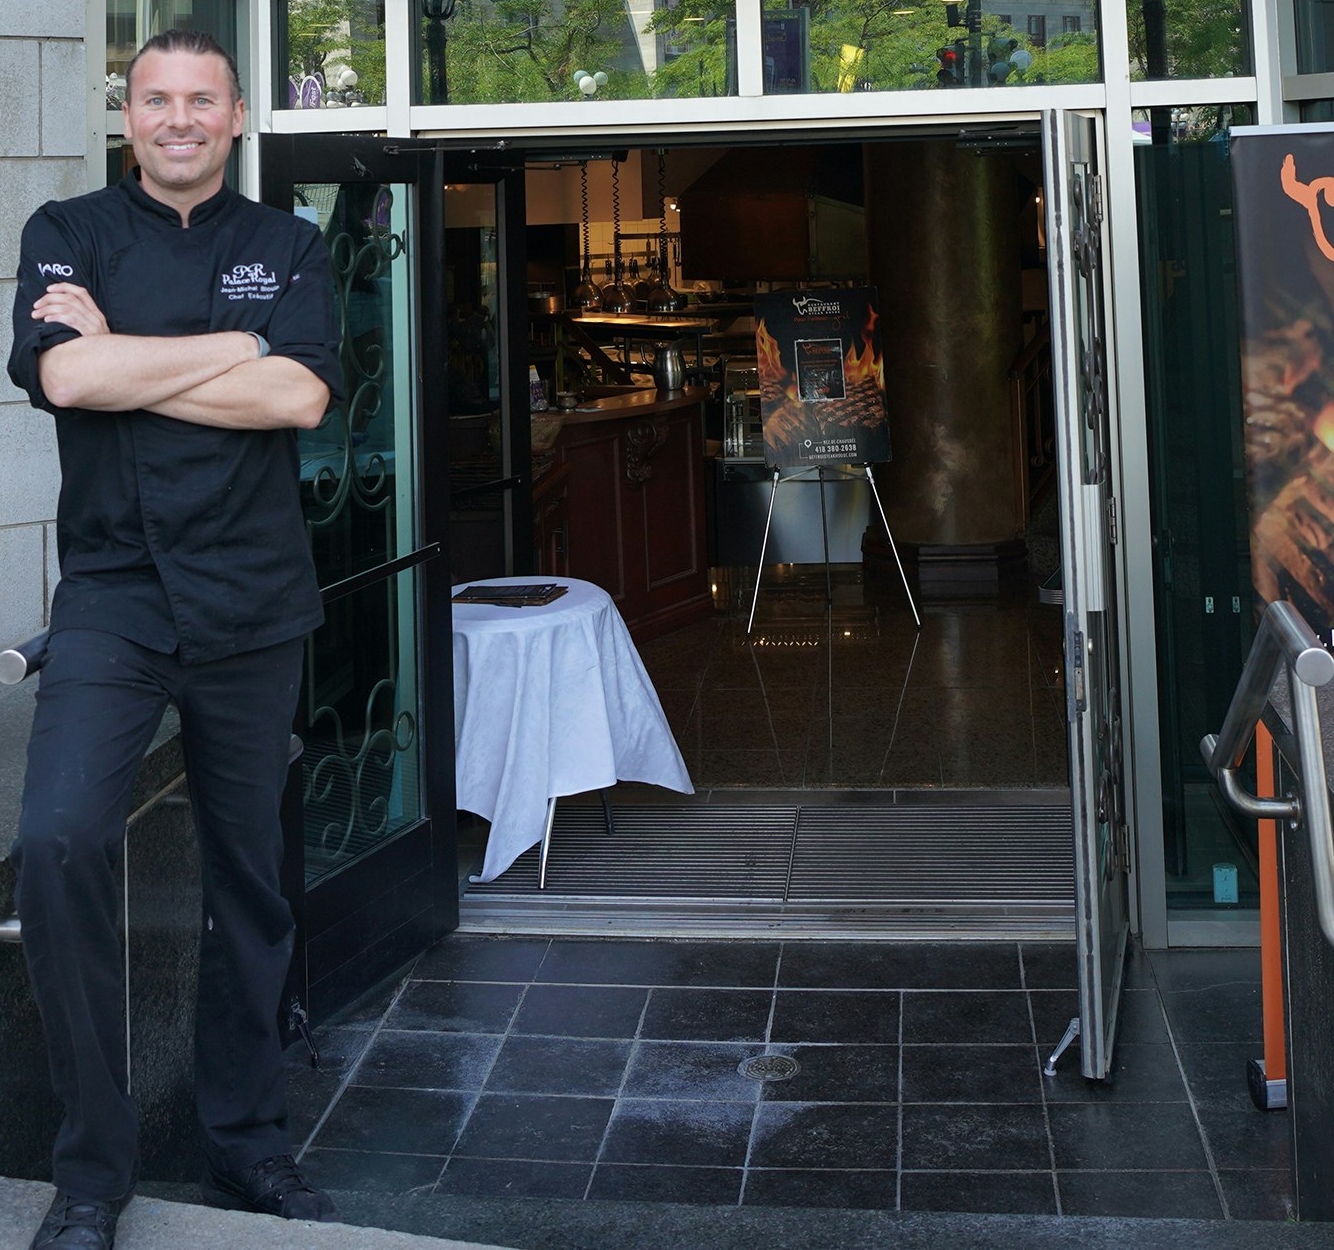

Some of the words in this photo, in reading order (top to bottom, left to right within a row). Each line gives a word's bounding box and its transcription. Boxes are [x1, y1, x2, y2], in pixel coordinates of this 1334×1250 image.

[222, 273, 250, 285] Palace
[249, 271, 277, 285] Royal
[814, 445, 826, 453] 418
